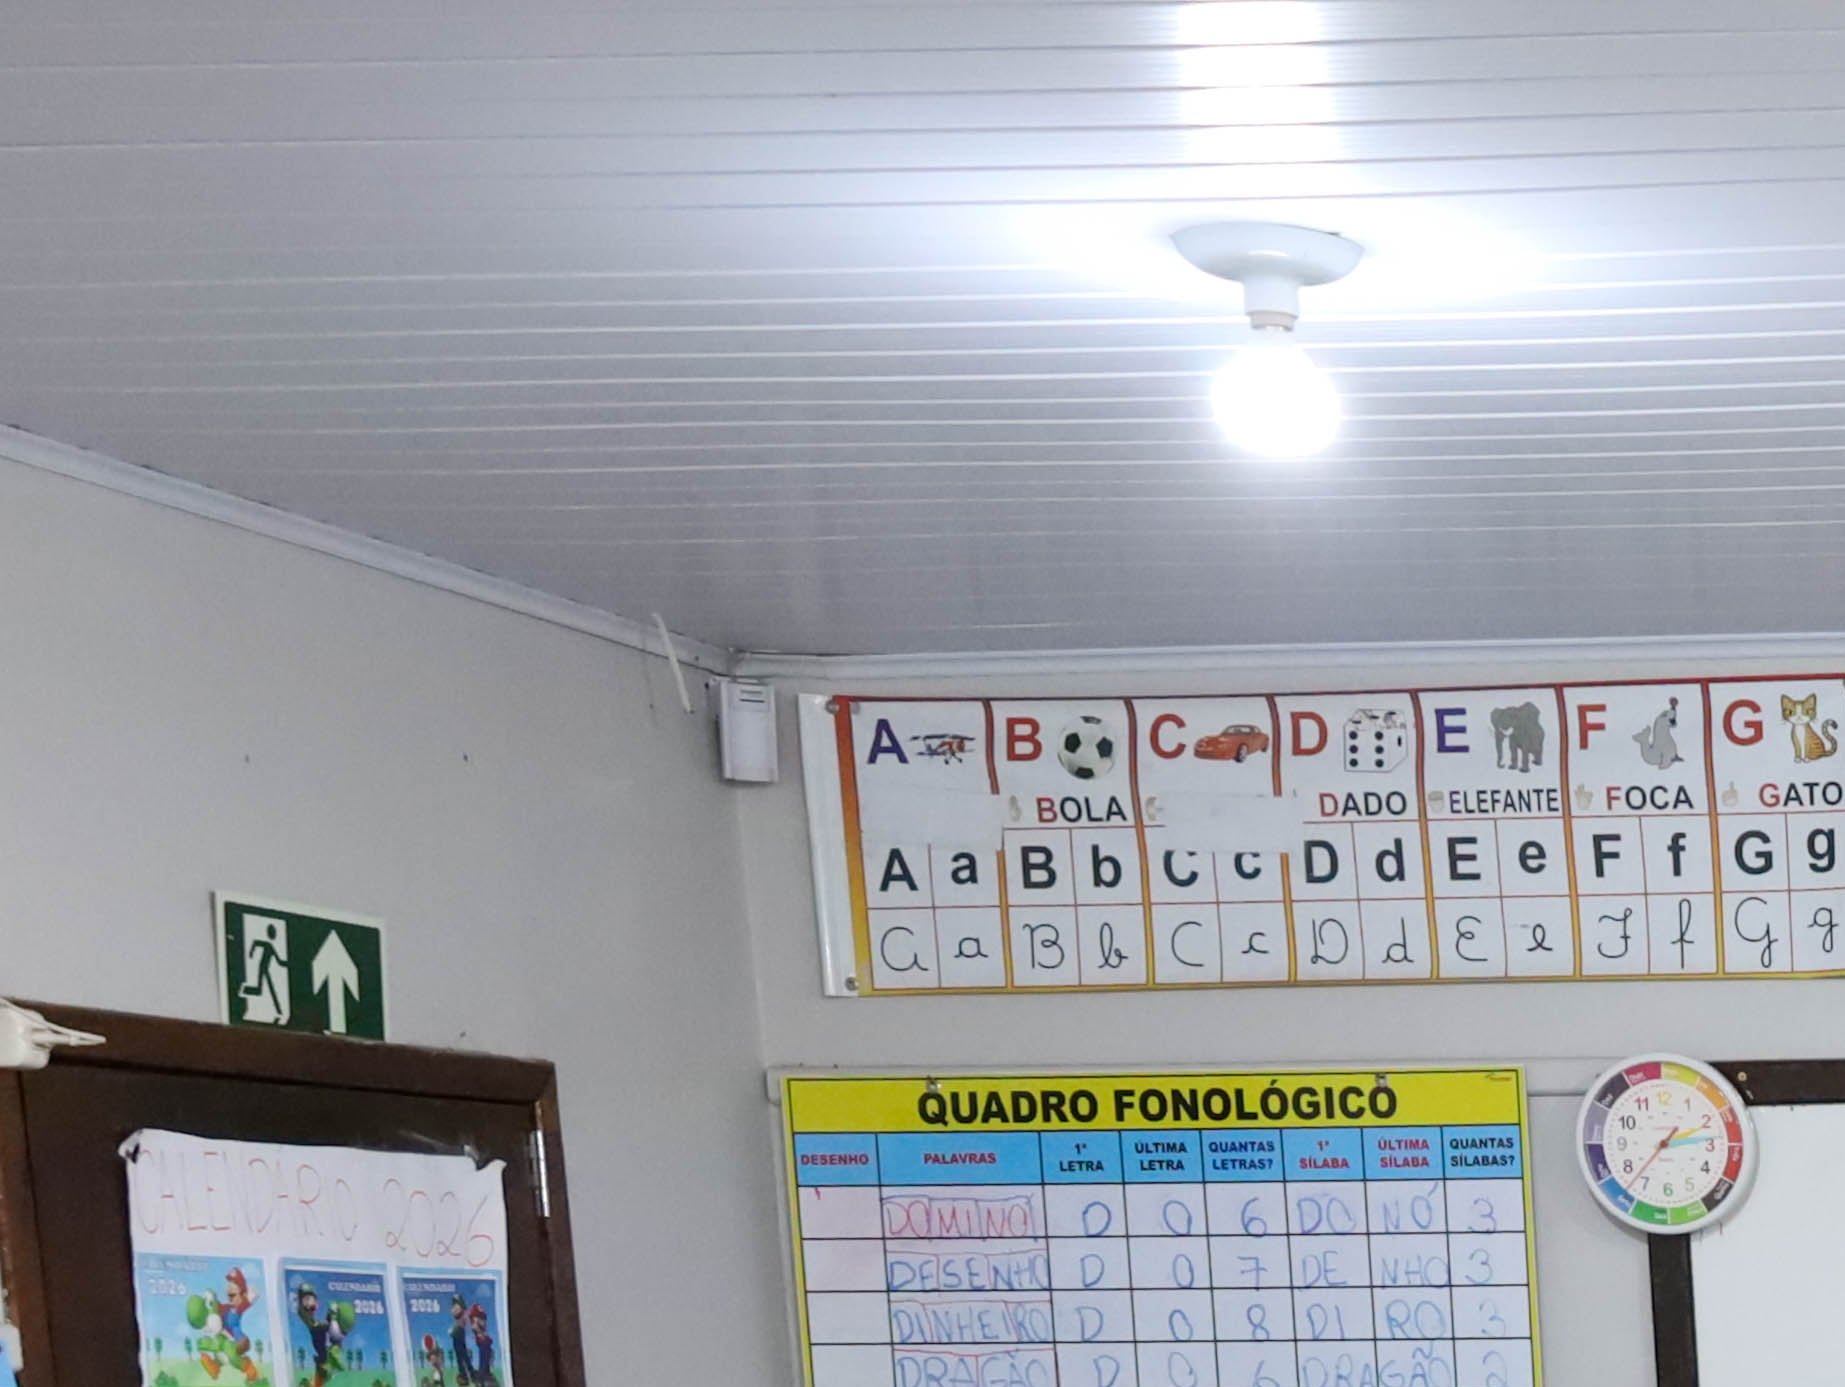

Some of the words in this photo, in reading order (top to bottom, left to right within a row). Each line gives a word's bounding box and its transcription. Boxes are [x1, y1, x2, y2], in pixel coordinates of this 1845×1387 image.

[1448, 787, 1559, 815] ELEFANTE
[1604, 783, 1692, 811] FOCA
[1758, 779, 1843, 808] GATO
[1037, 795, 1126, 823] BOLA
[1319, 789, 1408, 818] DADO
[917, 1089, 1099, 1126] QUADRO
[1114, 1080, 1397, 1122] FONOLÓGICO
[1208, 1140, 1275, 1154] QUANTAS
[1449, 1136, 1514, 1150] QUANTAS
[801, 1153, 869, 1166] DESENHO
[923, 1152, 997, 1165] PALAVRAS
[1059, 1160, 1104, 1172] LETRA
[1140, 1158, 1184, 1171] LETRA
[1212, 1158, 1274, 1171] LETRAS?
[1299, 1154, 1349, 1169] SÍLABA
[1380, 1153, 1430, 1168] SÍLABA
[1450, 1152, 1515, 1167] SÍLABAS?
[1301, 1251, 1347, 1288] DE
